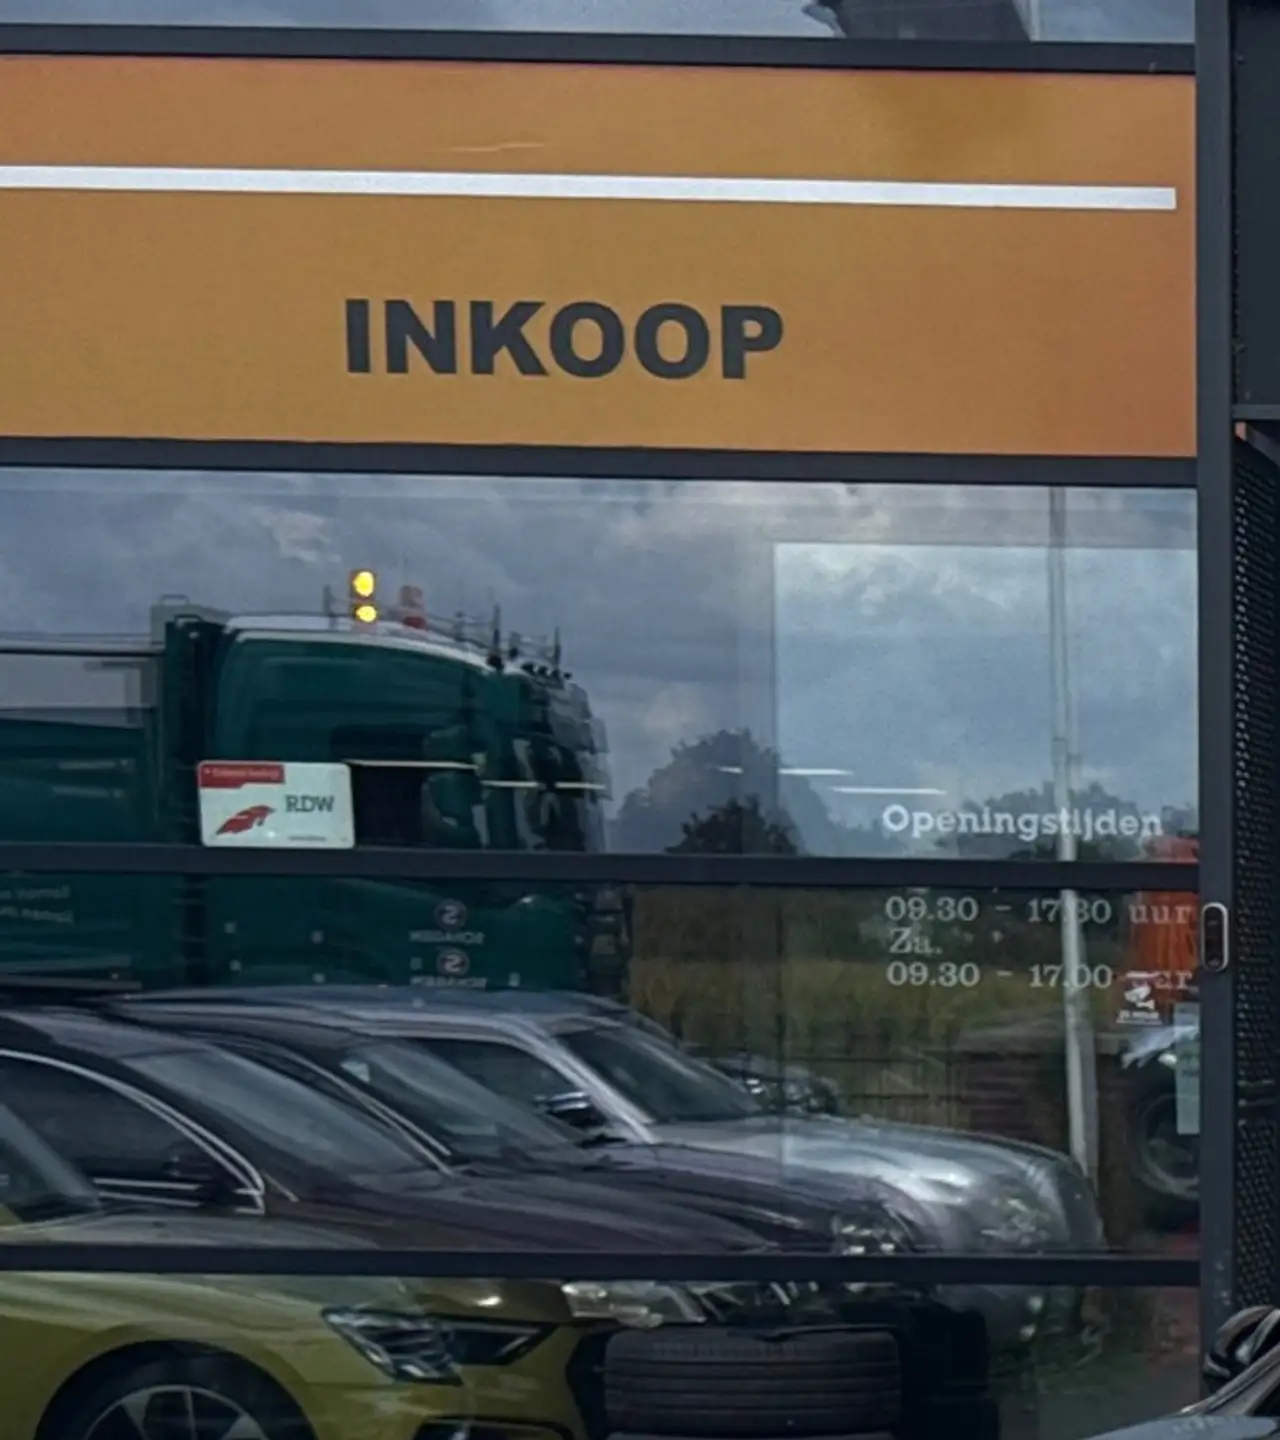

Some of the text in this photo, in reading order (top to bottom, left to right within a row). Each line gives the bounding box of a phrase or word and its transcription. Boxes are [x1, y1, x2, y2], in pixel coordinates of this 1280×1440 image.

[345, 298, 784, 380] INKOOP
[285, 795, 335, 814] RDW
[881, 803, 1164, 842] Openingstijden
[885, 896, 979, 922] 09.30
[1128, 903, 1192, 925] uur
[886, 961, 981, 987] 09.30
